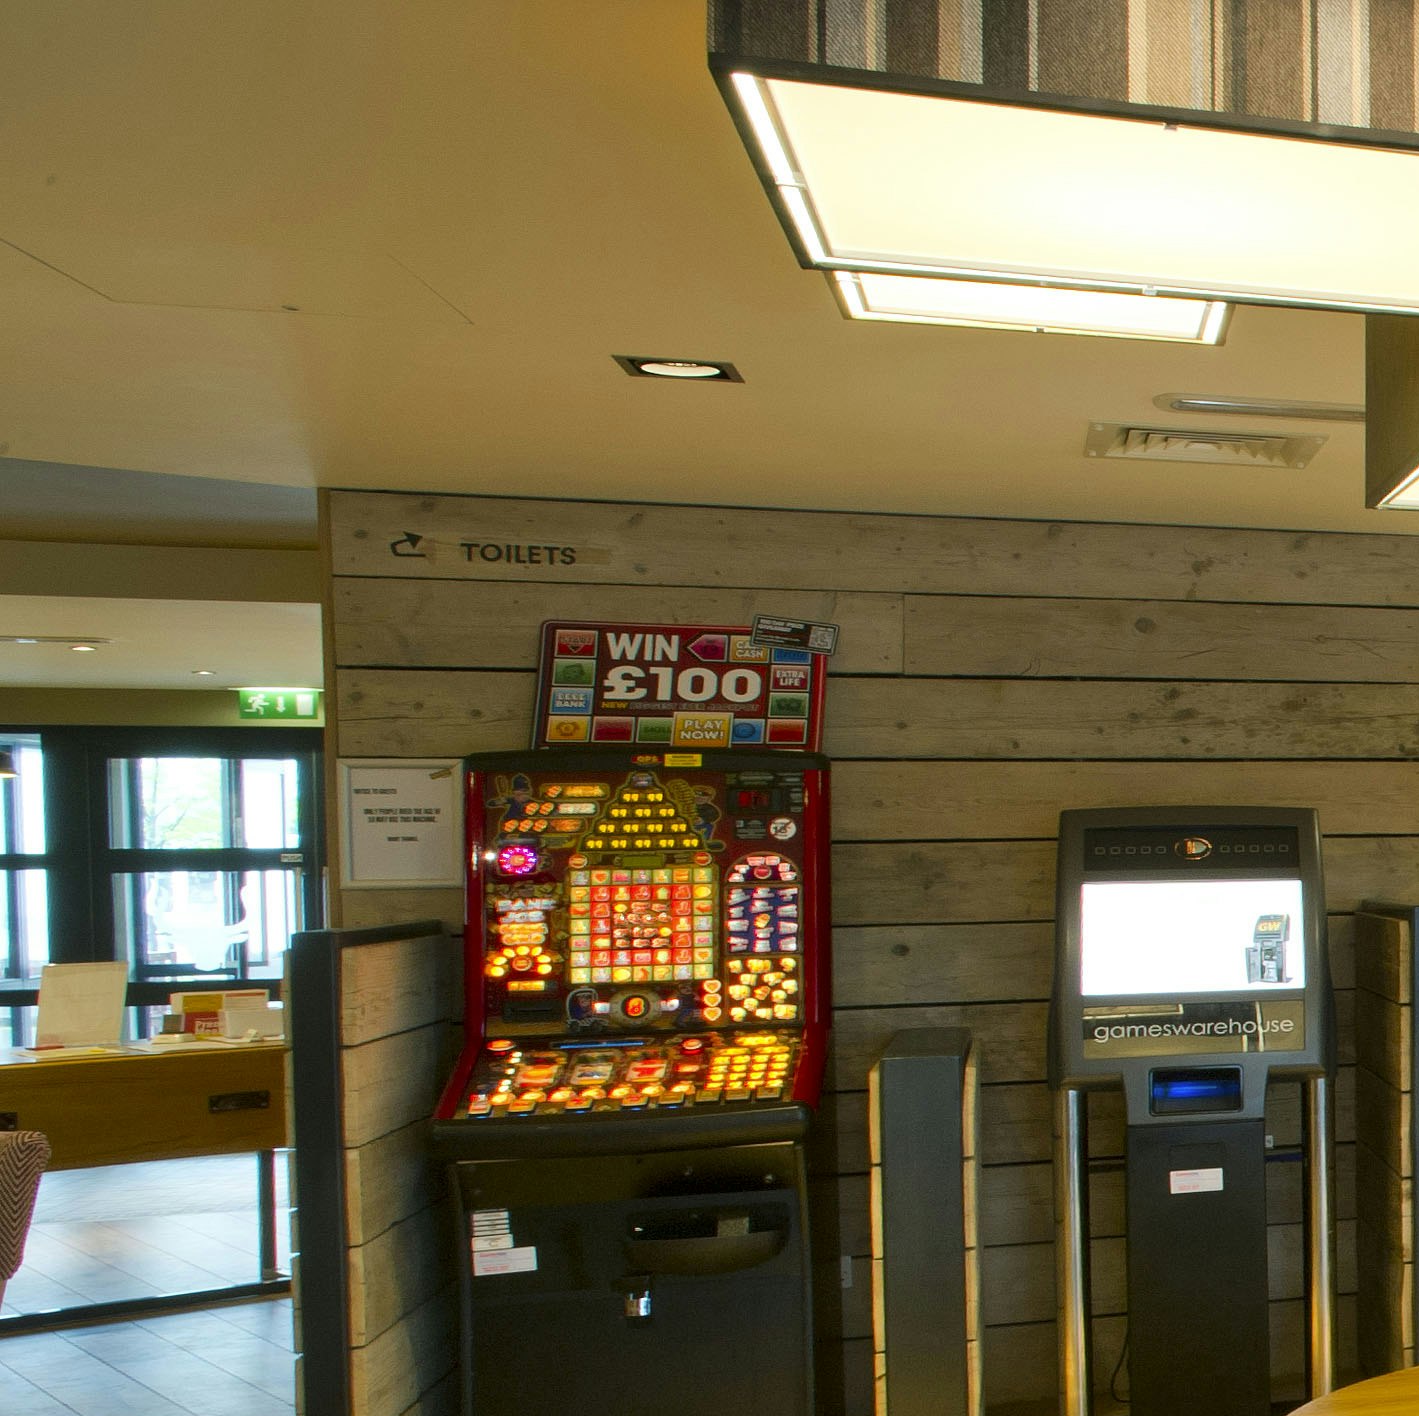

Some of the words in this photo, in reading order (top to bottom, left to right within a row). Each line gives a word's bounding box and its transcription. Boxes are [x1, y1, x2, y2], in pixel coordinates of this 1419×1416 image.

[459, 543, 577, 565] TOILETS
[606, 632, 680, 662] WIN
[603, 665, 762, 703] £100
[779, 678, 801, 687] LIFE
[684, 719, 723, 730] PLAY
[680, 729, 725, 741] NOW!
[1257, 921, 1282, 932] GW
[1093, 1017, 1295, 1044] gameswarehouse
